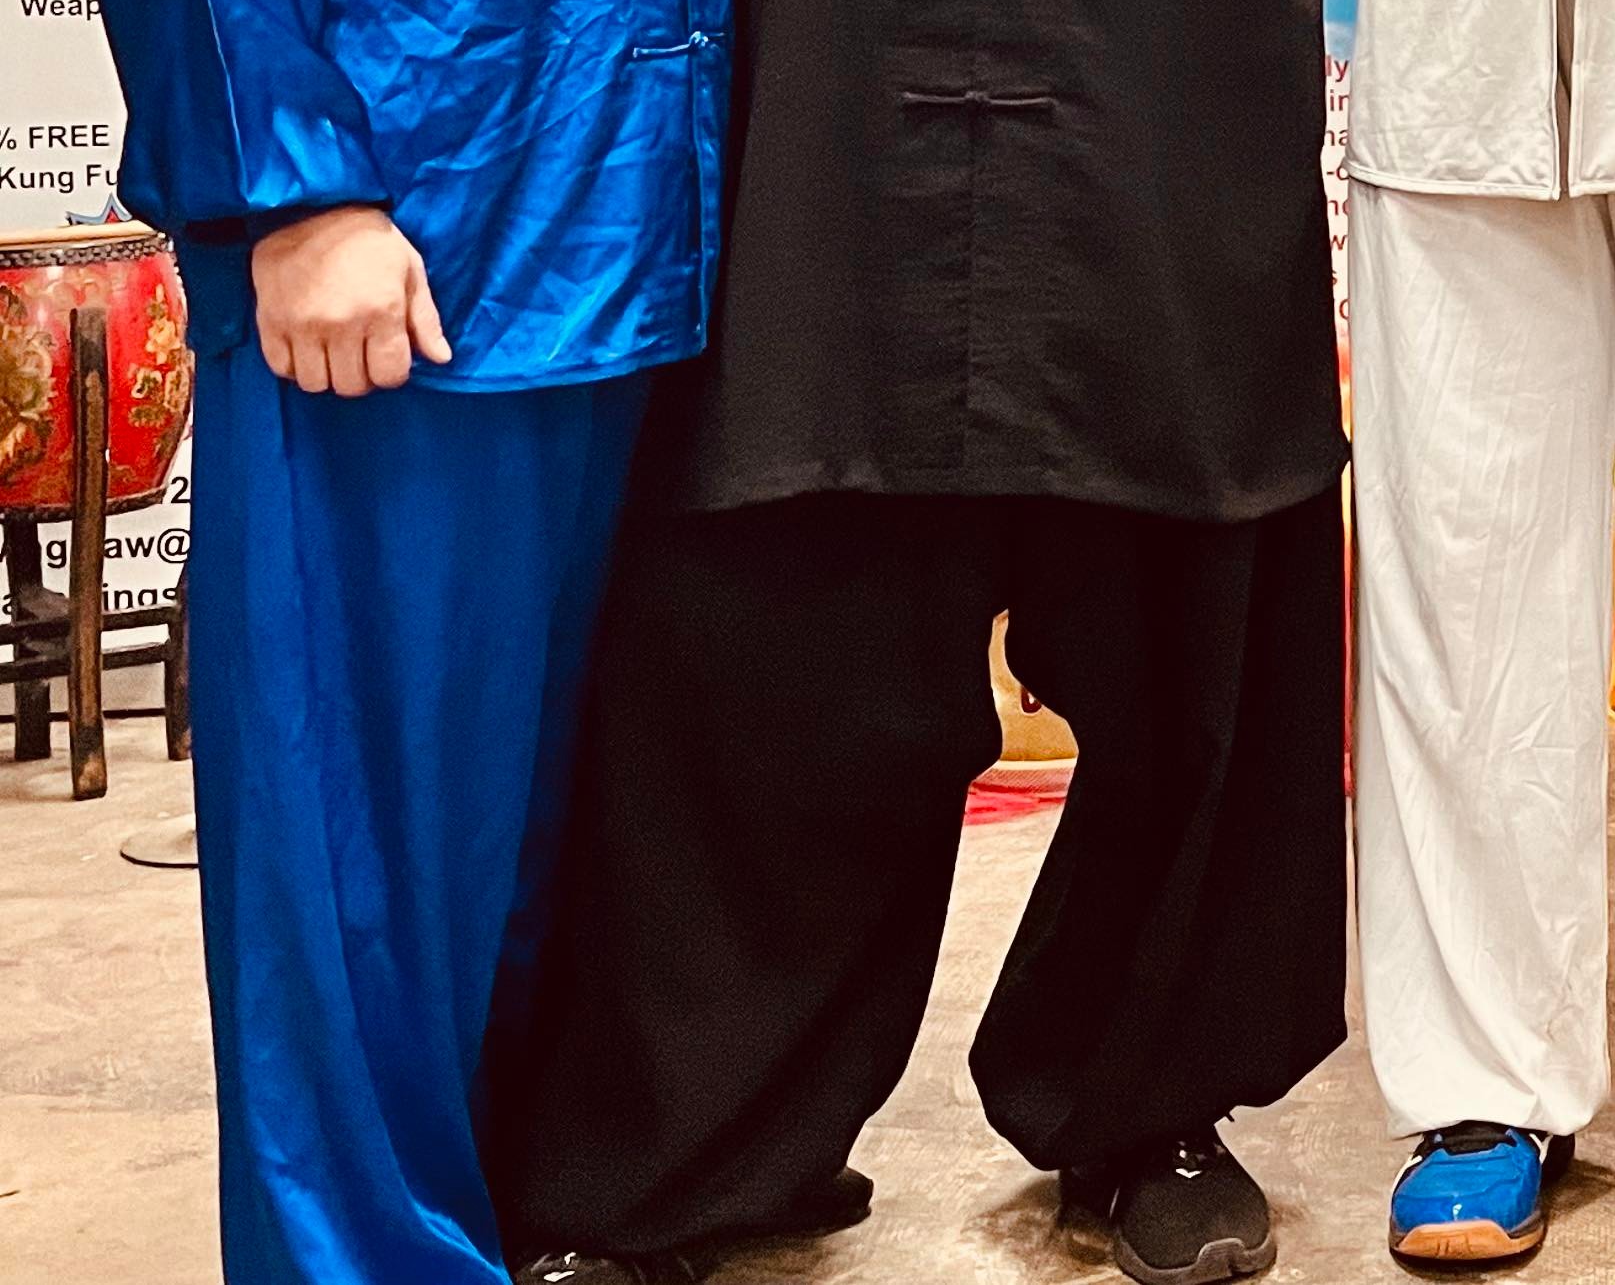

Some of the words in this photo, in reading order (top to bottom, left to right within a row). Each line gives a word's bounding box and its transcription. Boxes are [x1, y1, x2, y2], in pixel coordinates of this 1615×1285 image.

[29, 125, 109, 149] FREE
[0, 167, 74, 194] Kung
[86, 164, 118, 189] Fu
